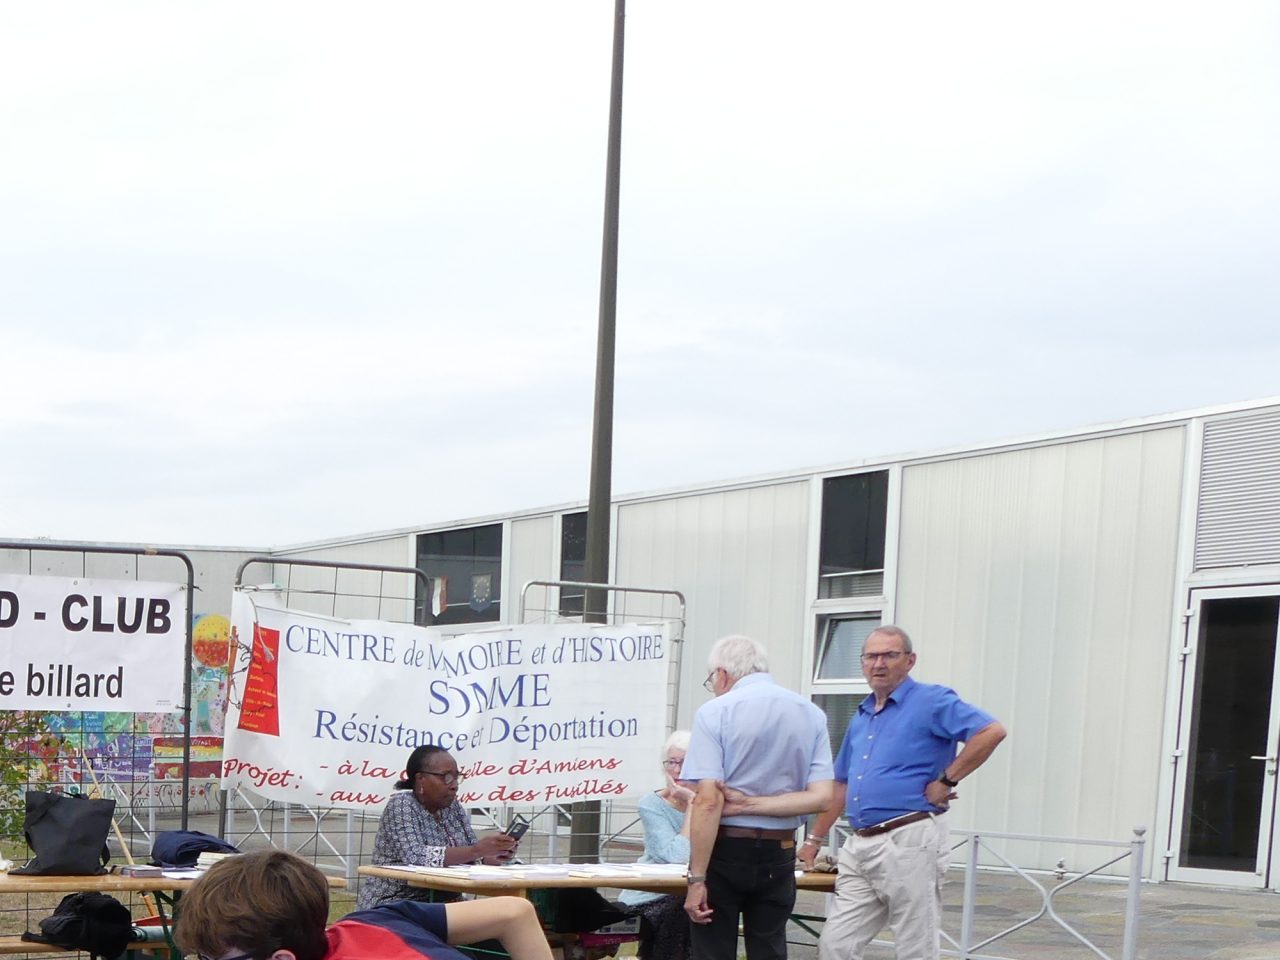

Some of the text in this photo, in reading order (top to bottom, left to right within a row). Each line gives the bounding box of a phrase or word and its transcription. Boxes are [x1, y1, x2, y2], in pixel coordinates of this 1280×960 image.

[61, 594, 172, 634] CLUB
[285, 624, 396, 664] CENTRE
[403, 639, 424, 668] de
[531, 642, 547, 665] et
[552, 634, 664, 665] d'HISTOIRE
[26, 663, 124, 698] billard
[312, 709, 468, 751] Résistance
[488, 711, 638, 750] Déportation
[338, 760, 359, 775] à
[361, 760, 397, 778] la
[508, 758, 623, 776] d'Amiens
[330, 789, 385, 805] aux
[488, 786, 541, 802] des
[545, 779, 629, 802] Fusillés
